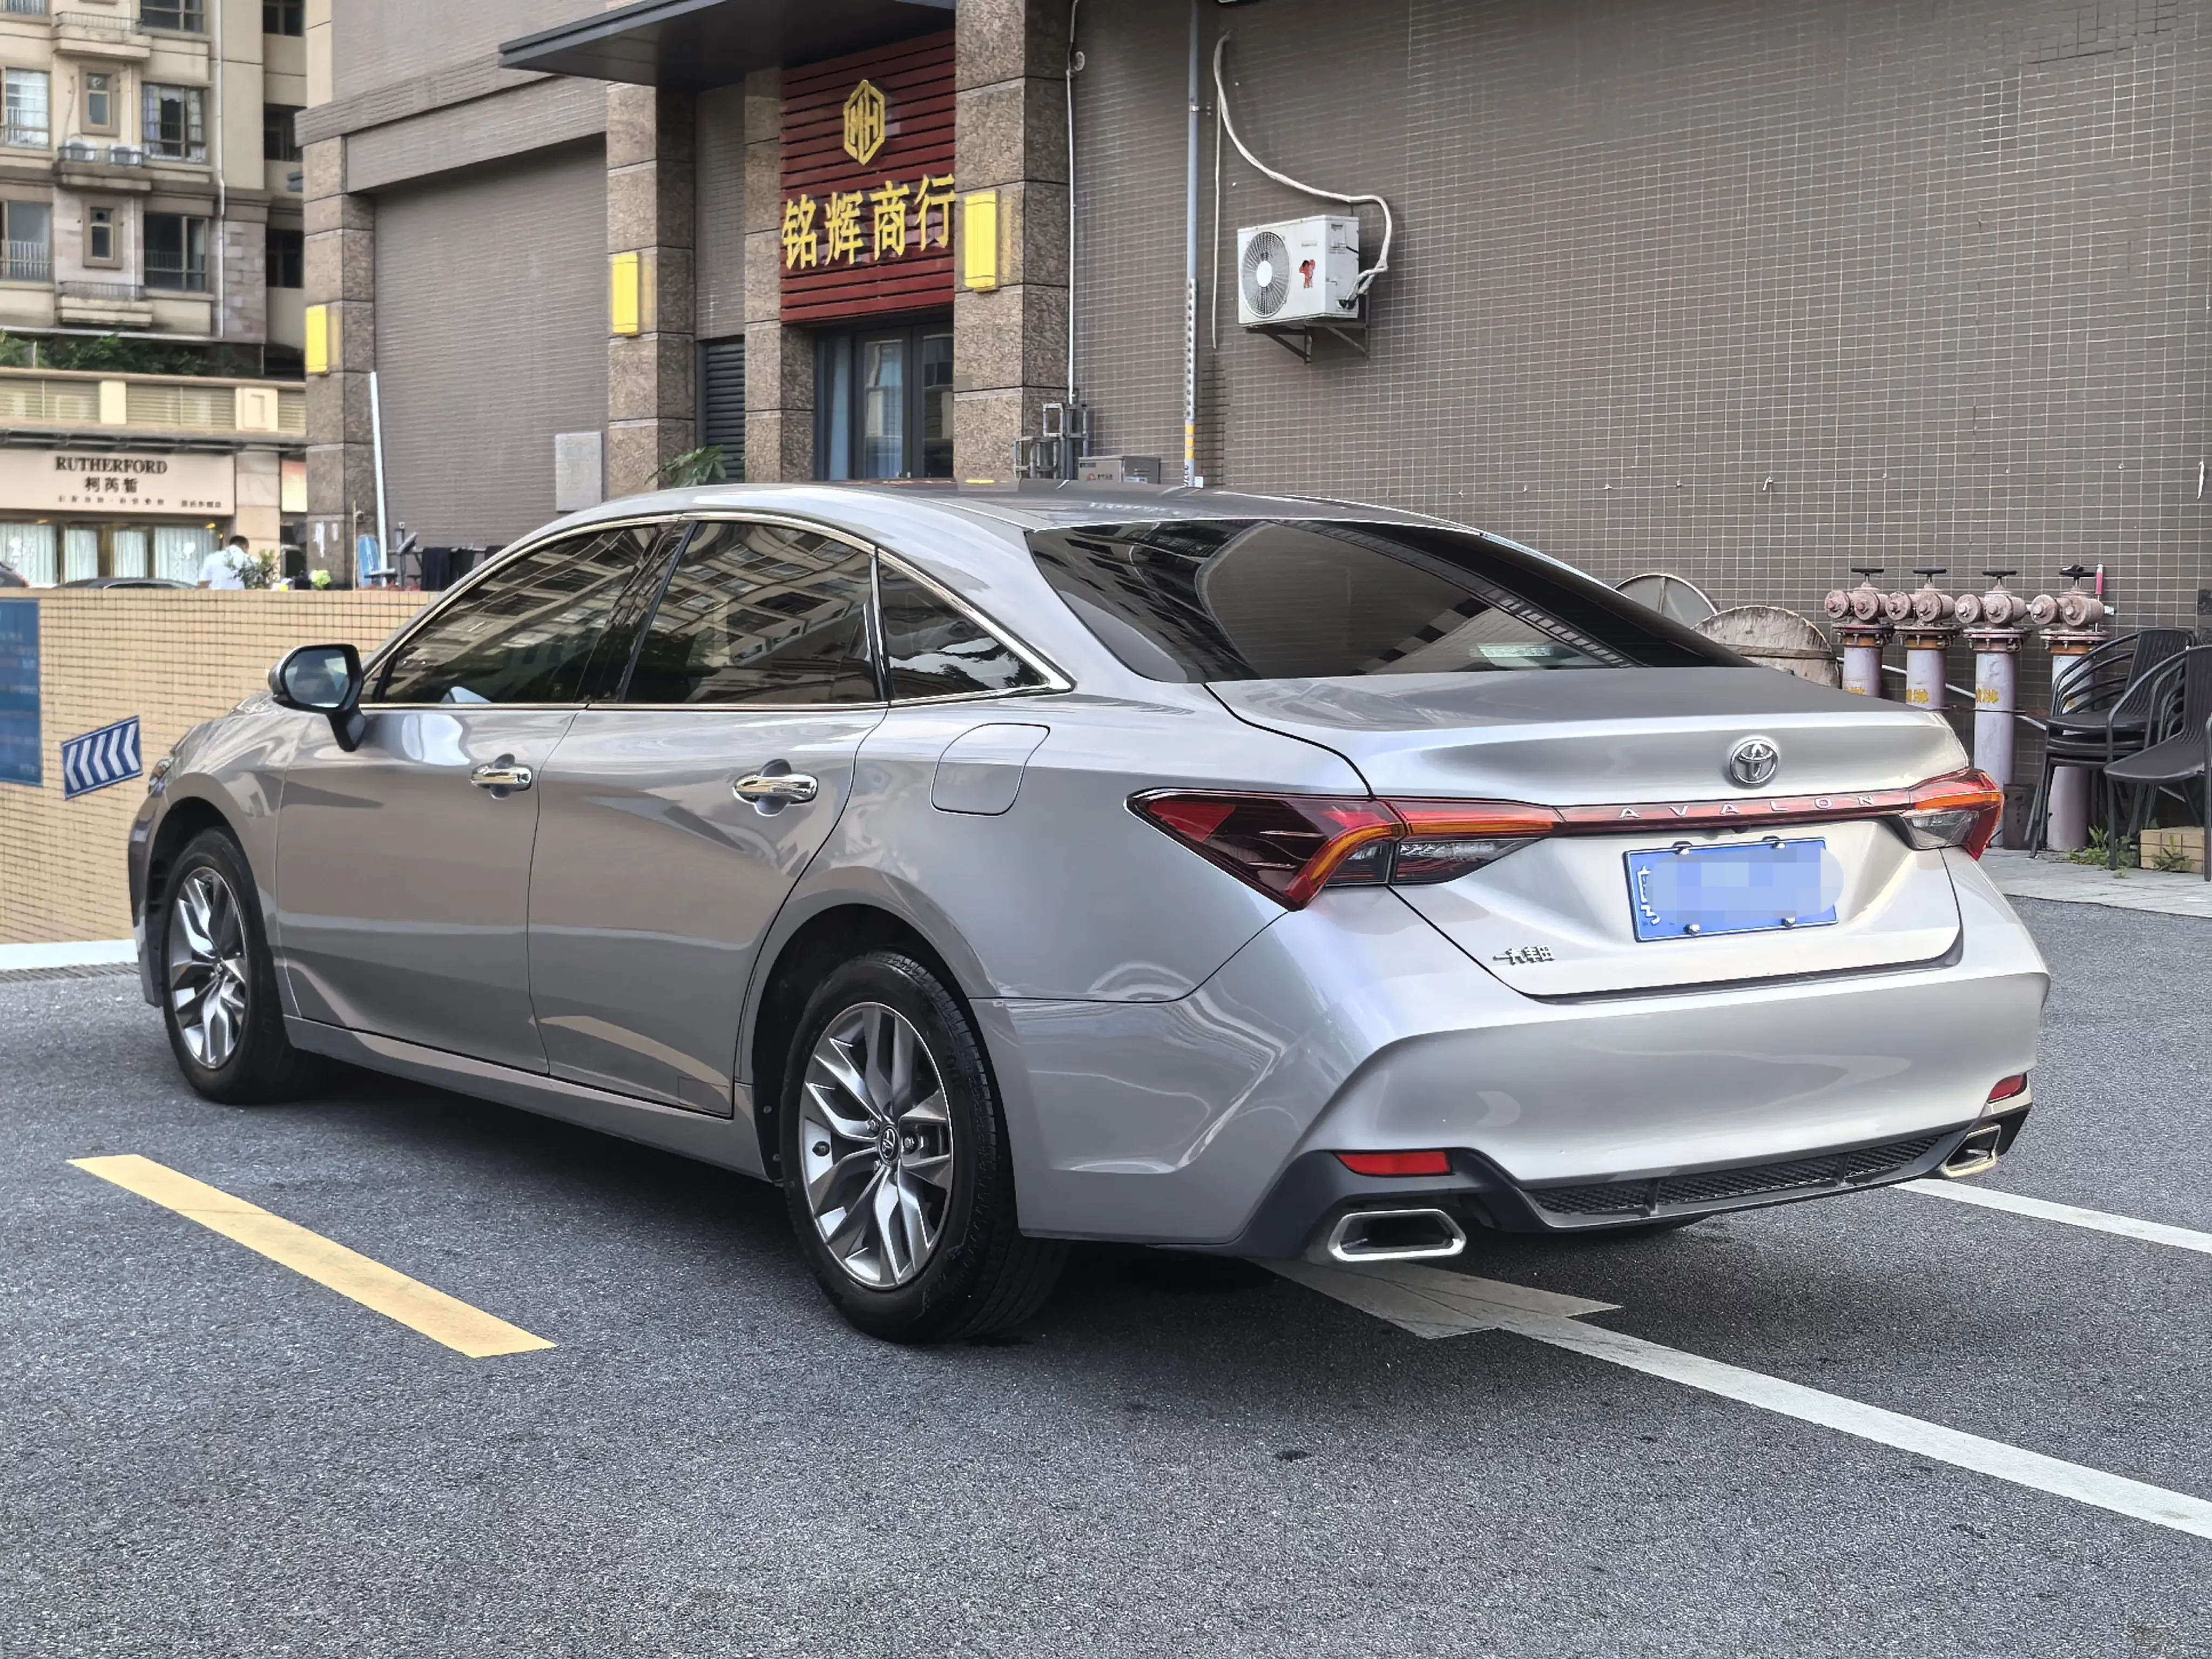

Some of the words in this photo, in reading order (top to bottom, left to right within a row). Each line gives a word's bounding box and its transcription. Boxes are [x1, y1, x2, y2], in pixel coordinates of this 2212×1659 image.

[781, 173, 956, 270] 铭辉商行
[55, 456, 167, 474] RUTHERFORD
[1619, 795, 1874, 819] AVALON
[1492, 945, 1555, 966] 一汽丰田
